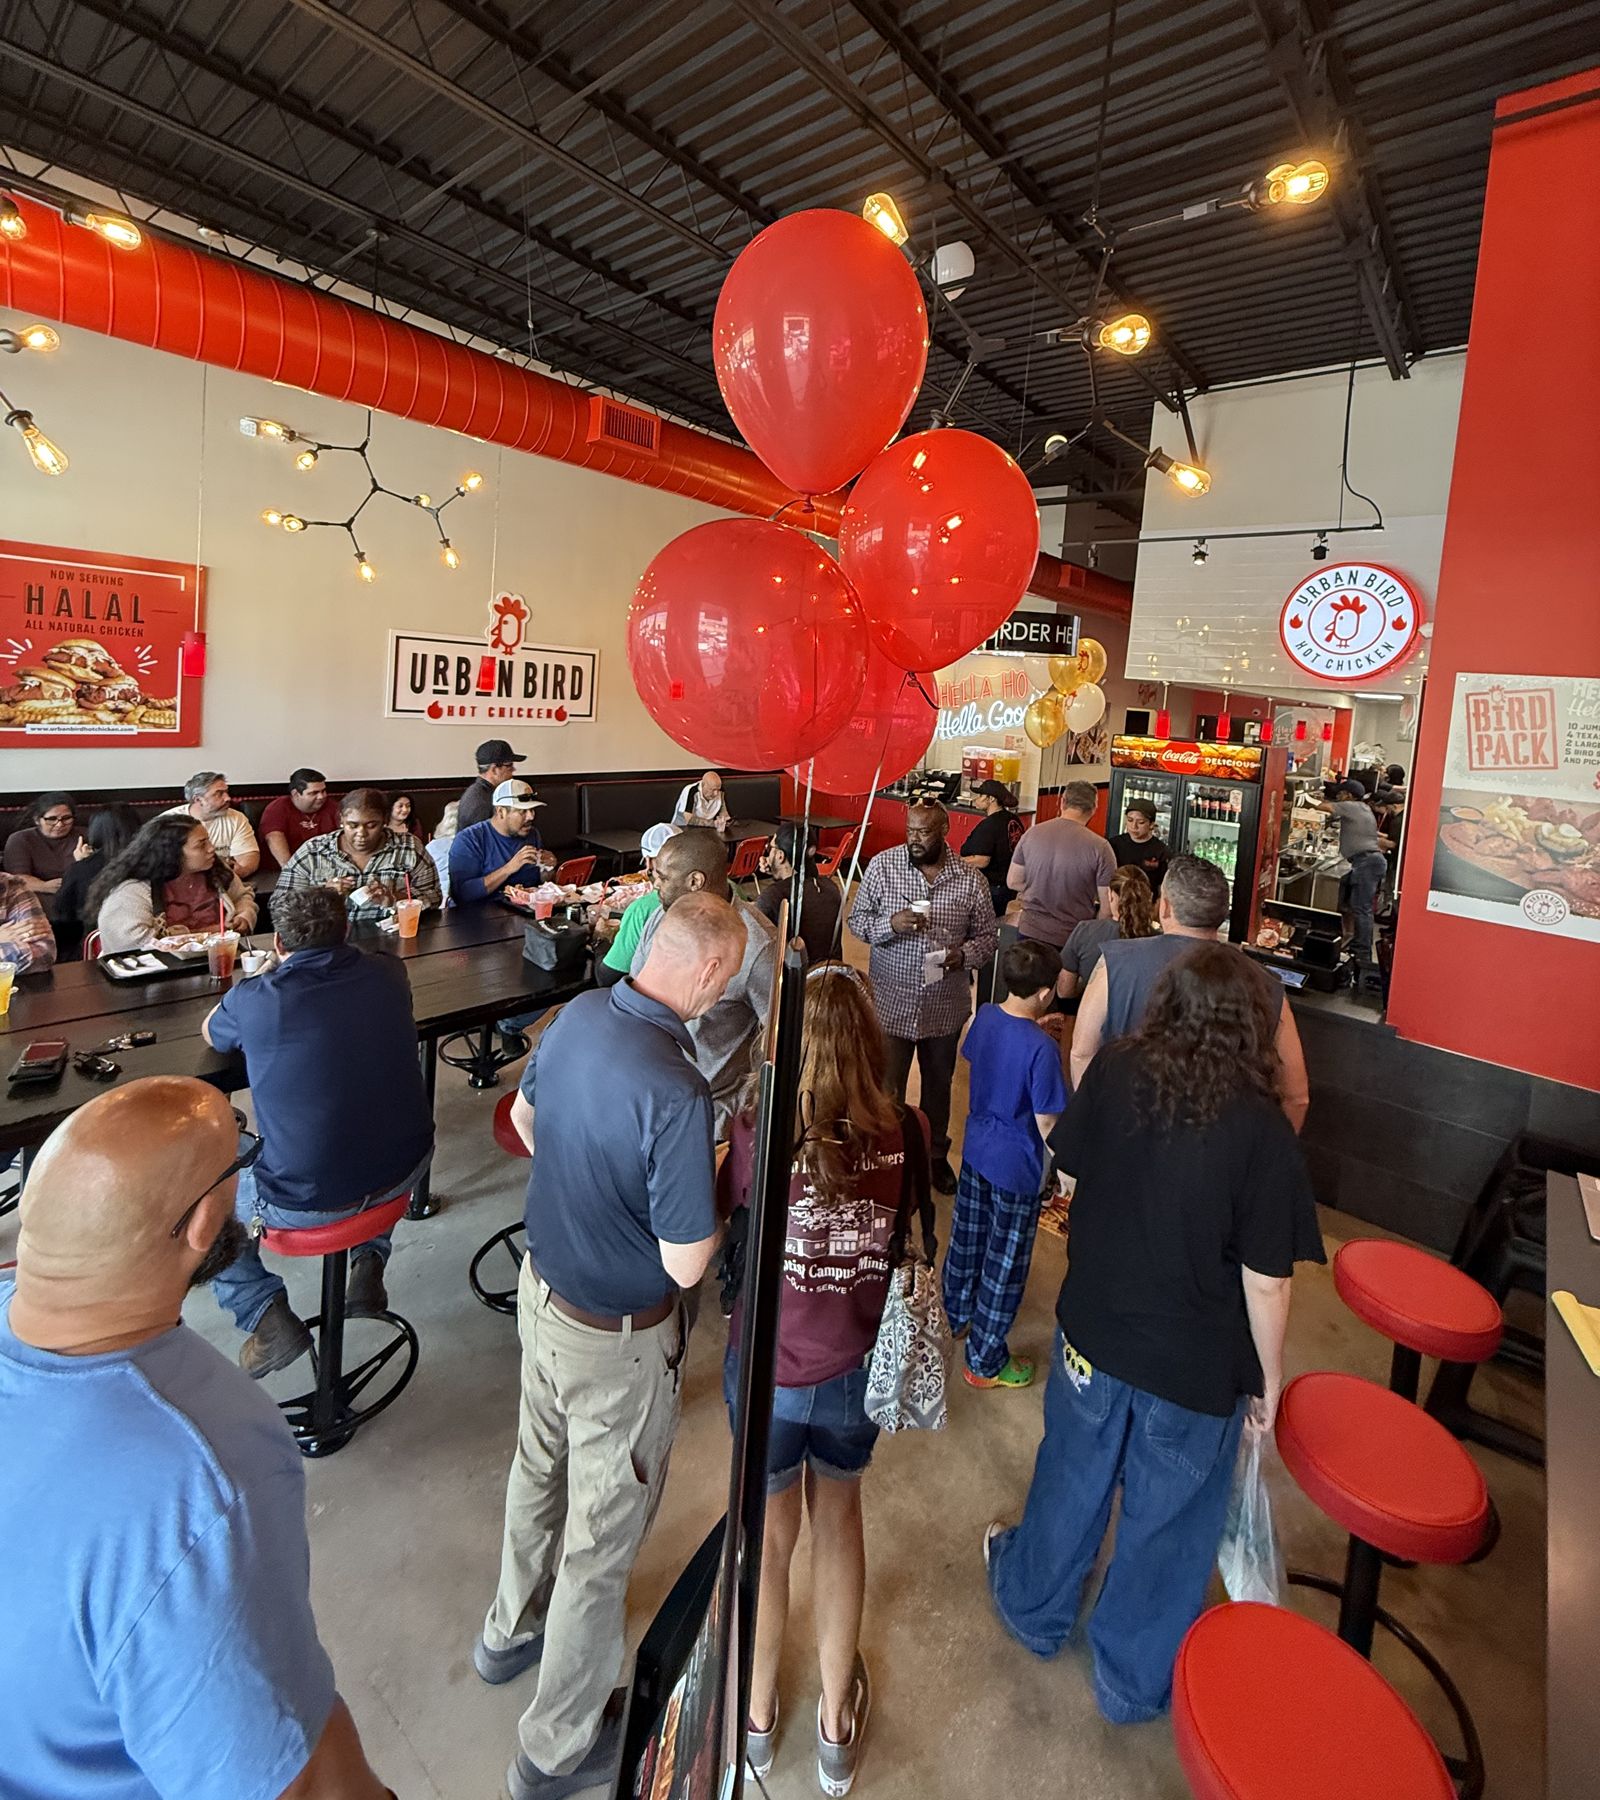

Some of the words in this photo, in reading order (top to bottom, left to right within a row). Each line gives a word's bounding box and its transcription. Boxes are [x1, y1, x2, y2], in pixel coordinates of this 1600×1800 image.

[50, 569, 75, 581] NOW
[79, 573, 124, 587] SERVING
[1296, 570, 1359, 607] URBAN
[1364, 573, 1405, 608] BIRD
[24, 582, 145, 624] HALAL
[25, 619, 44, 631] ALL
[48, 621, 95, 634] NATURAL
[100, 625, 144, 638] CHICKEN
[990, 622, 1051, 643] RDER
[1056, 625, 1073, 645] HE
[1295, 640, 1322, 664] HOT
[1325, 641, 1396, 672] CHICKEN
[410, 652, 514, 698] URBN
[523, 661, 584, 700] BIRD
[939, 674, 993, 709] HELLA
[1001, 670, 1028, 700] HO
[447, 705, 478, 718] HOT
[488, 706, 554, 719] CHICKEN
[938, 702, 987, 740] Hella
[1476, 732, 1550, 766] PACK
[1575, 732, 1600, 740] TEXA
[1205, 757, 1259, 768] DELICIOUS
[808, 1264, 857, 1281] Campus
[858, 1255, 889, 1272] Minis
[816, 1284, 847, 1294] SERVE
